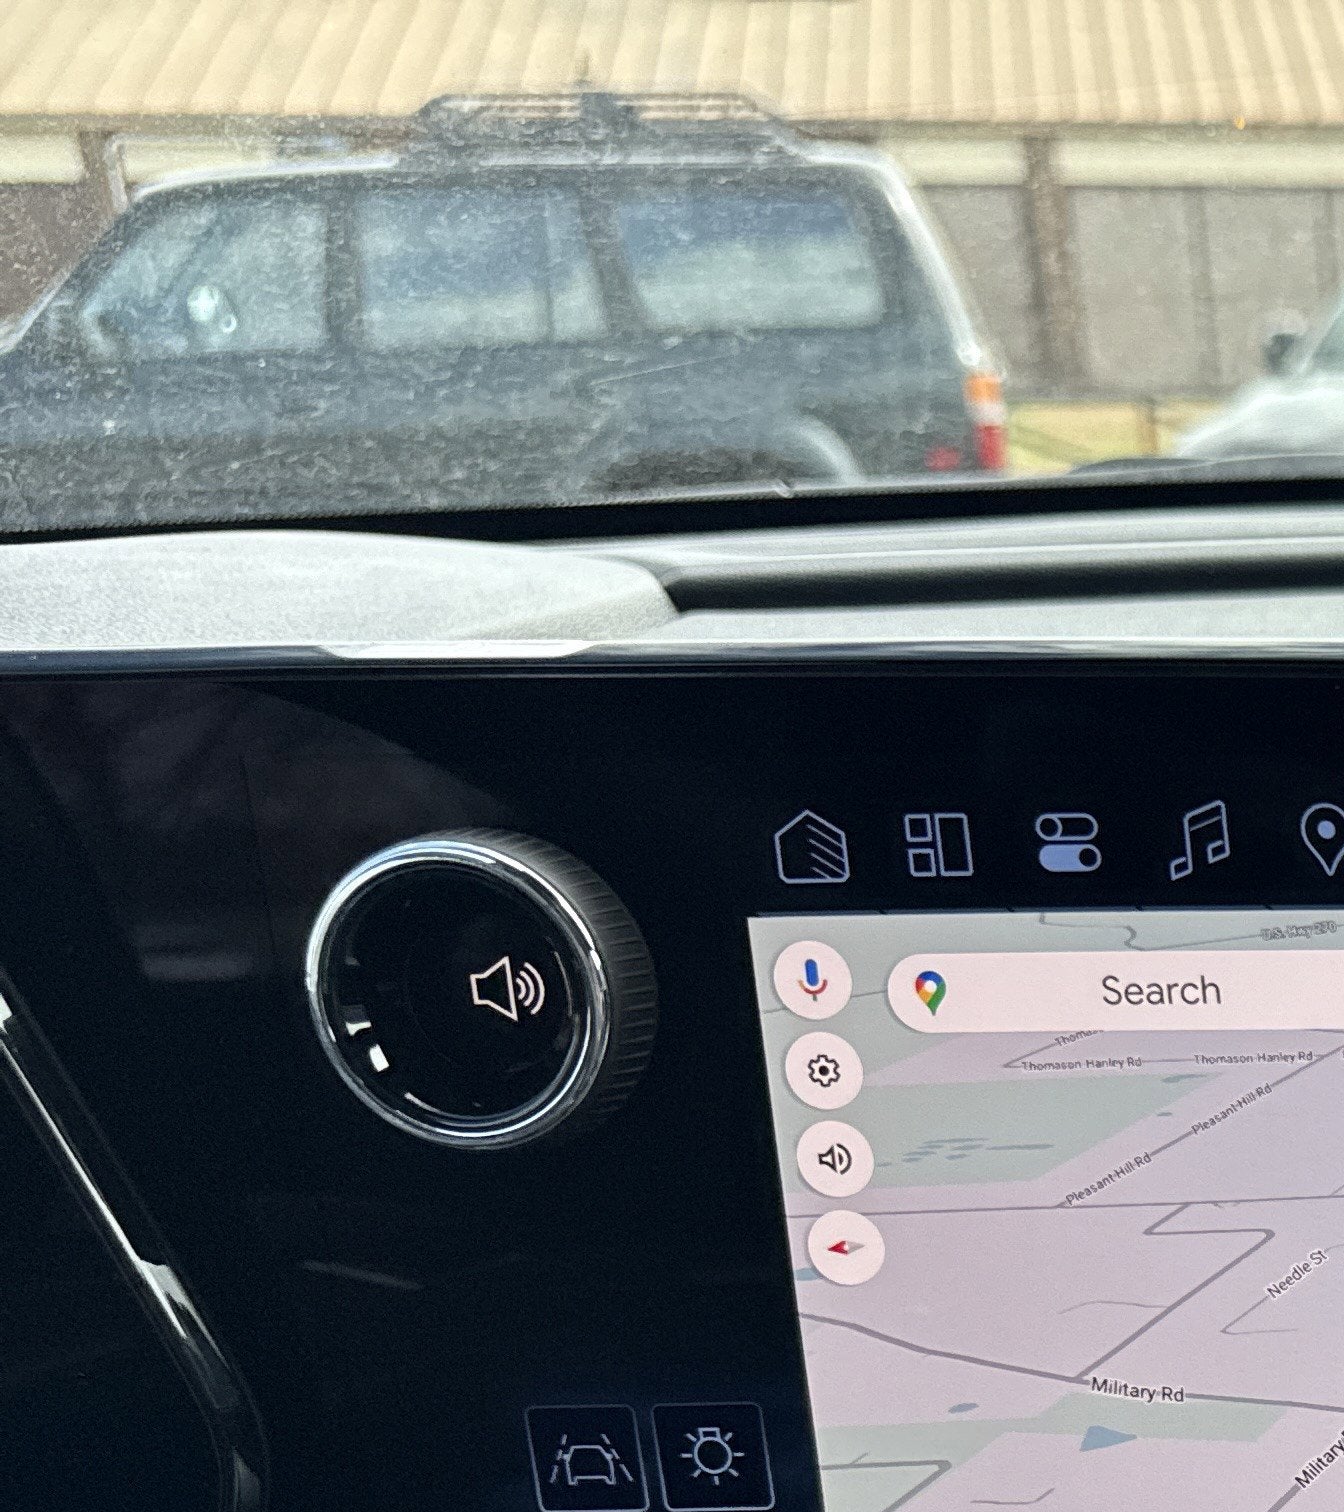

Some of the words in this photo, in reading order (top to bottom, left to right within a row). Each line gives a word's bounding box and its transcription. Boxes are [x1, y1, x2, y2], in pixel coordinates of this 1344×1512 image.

[1101, 975, 1222, 1006] Search
[1268, 1261, 1311, 1299] Needle
[1306, 1249, 1328, 1270] St
[1091, 1377, 1155, 1401] Military
[1162, 1385, 1184, 1402] Rd
